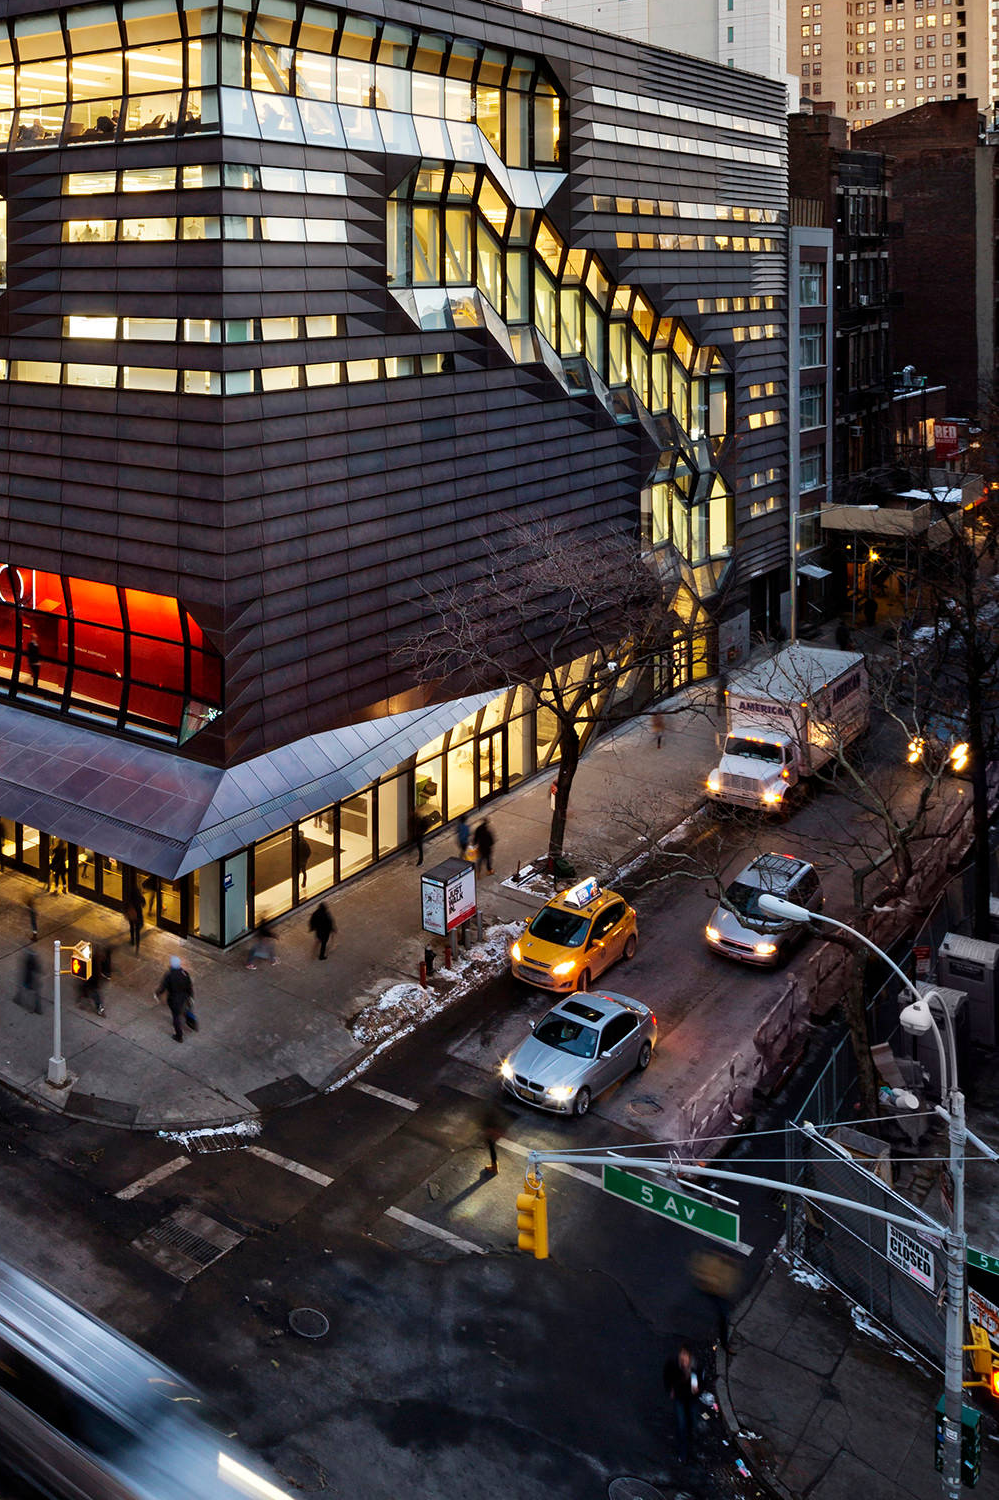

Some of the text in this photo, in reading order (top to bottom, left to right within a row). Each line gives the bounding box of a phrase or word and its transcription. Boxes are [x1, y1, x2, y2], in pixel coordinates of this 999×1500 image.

[935, 425, 957, 438] RED
[738, 701, 792, 717] AMERICAN
[641, 1185, 696, 1220] 5 Av
[890, 1226, 930, 1261] SIDEWALK
[890, 1238, 931, 1277] CLOSED
[980, 1255, 989, 1268] 5
